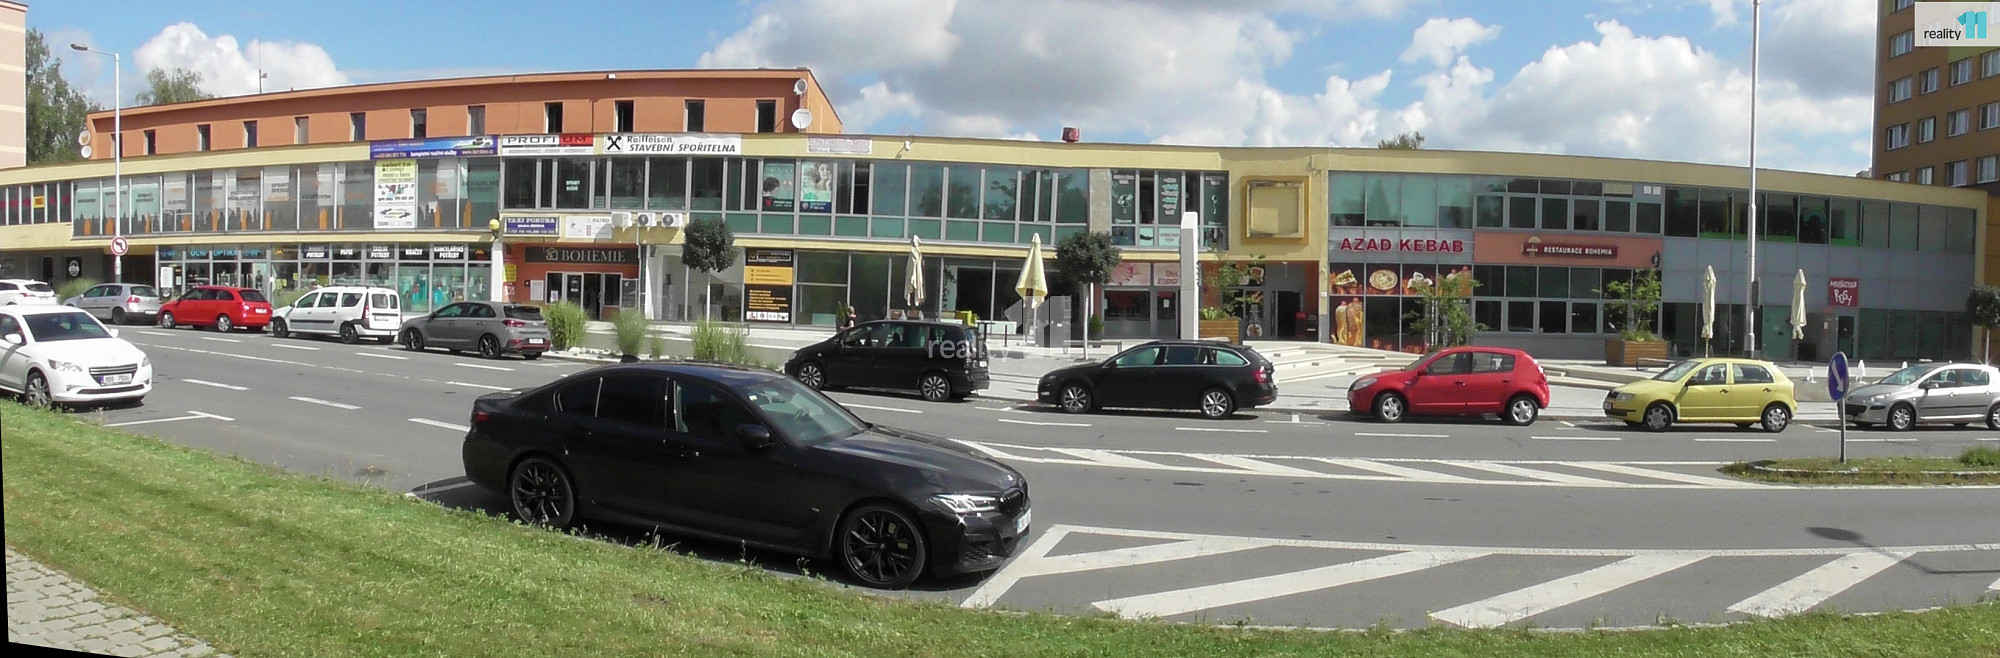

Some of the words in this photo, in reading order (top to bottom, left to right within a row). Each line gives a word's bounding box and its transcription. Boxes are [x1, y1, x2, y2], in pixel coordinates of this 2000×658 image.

[627, 135, 672, 143] Raiffeisen
[629, 142, 675, 152] STAVEBNÍ
[678, 142, 736, 152] SPOŘITELNA
[1340, 237, 1392, 251] AZAD
[1399, 239, 1464, 253] KEBAB
[1543, 246, 1582, 254] RESTAURACE
[1585, 247, 1612, 255] BOHEMIA
[562, 250, 626, 262] BOHEMIE
